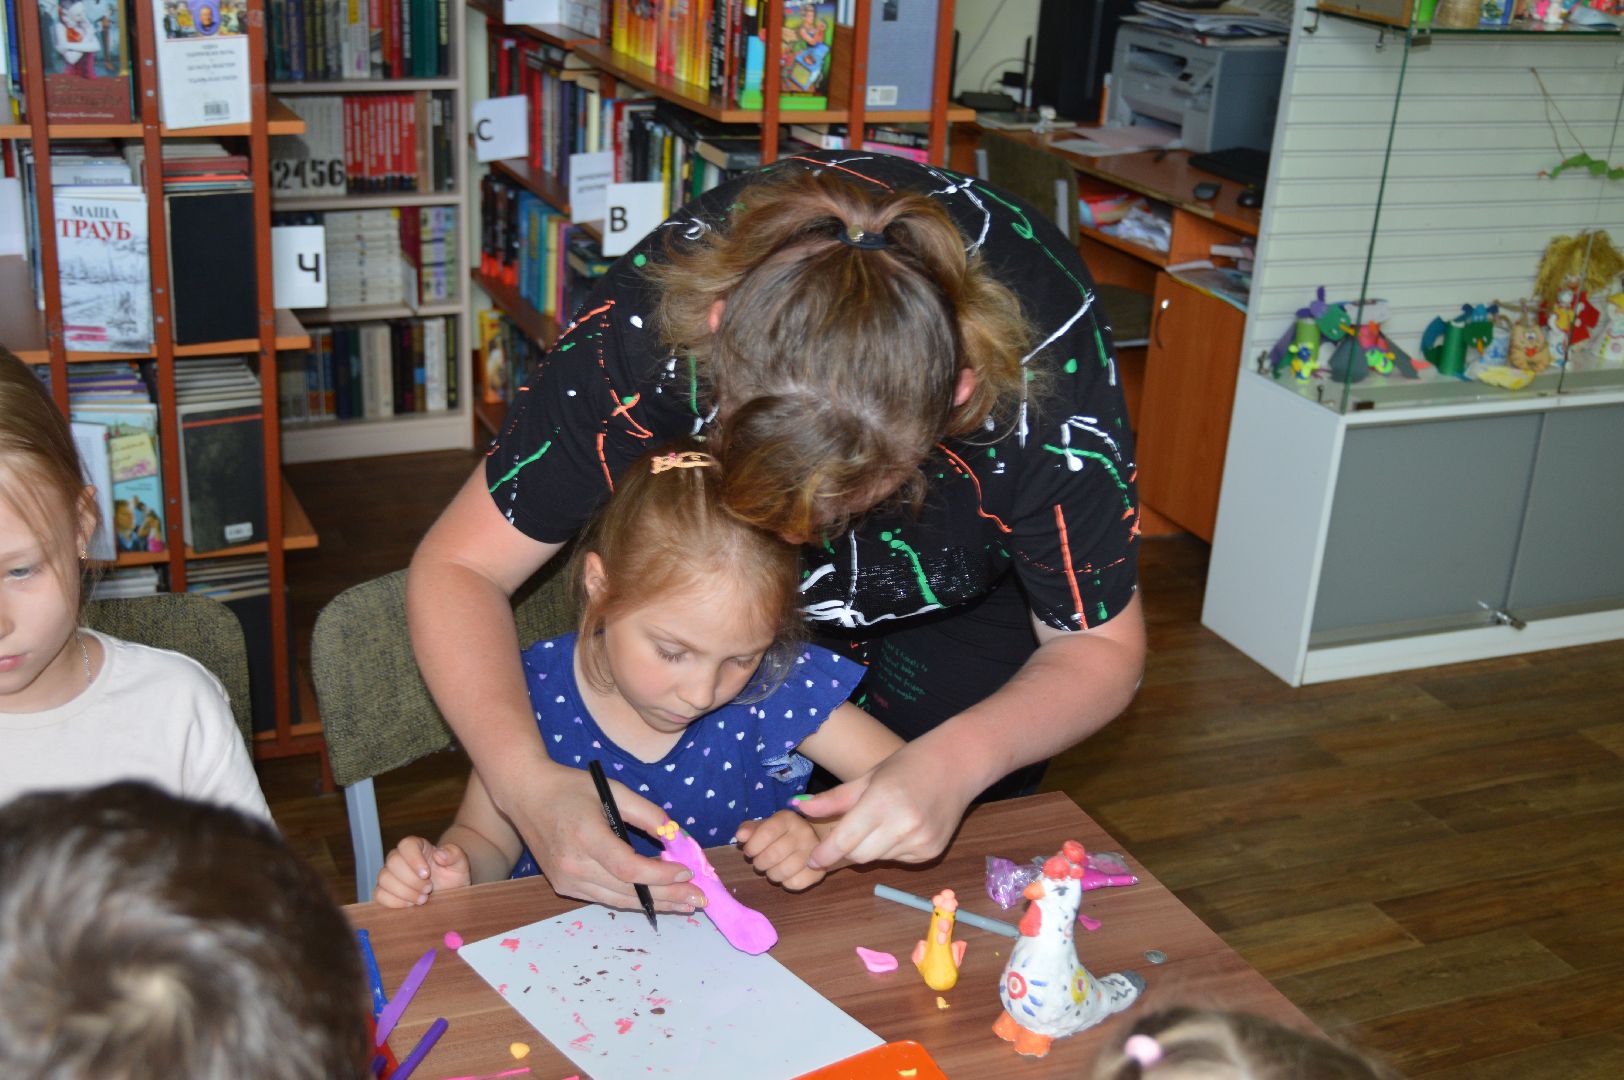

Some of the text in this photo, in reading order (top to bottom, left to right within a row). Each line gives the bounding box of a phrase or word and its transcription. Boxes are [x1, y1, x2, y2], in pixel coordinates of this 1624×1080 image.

[72, 205, 119, 219] МАША
[58, 219, 132, 241] ТРАУБ
[298, 253, 320, 282] Ч
